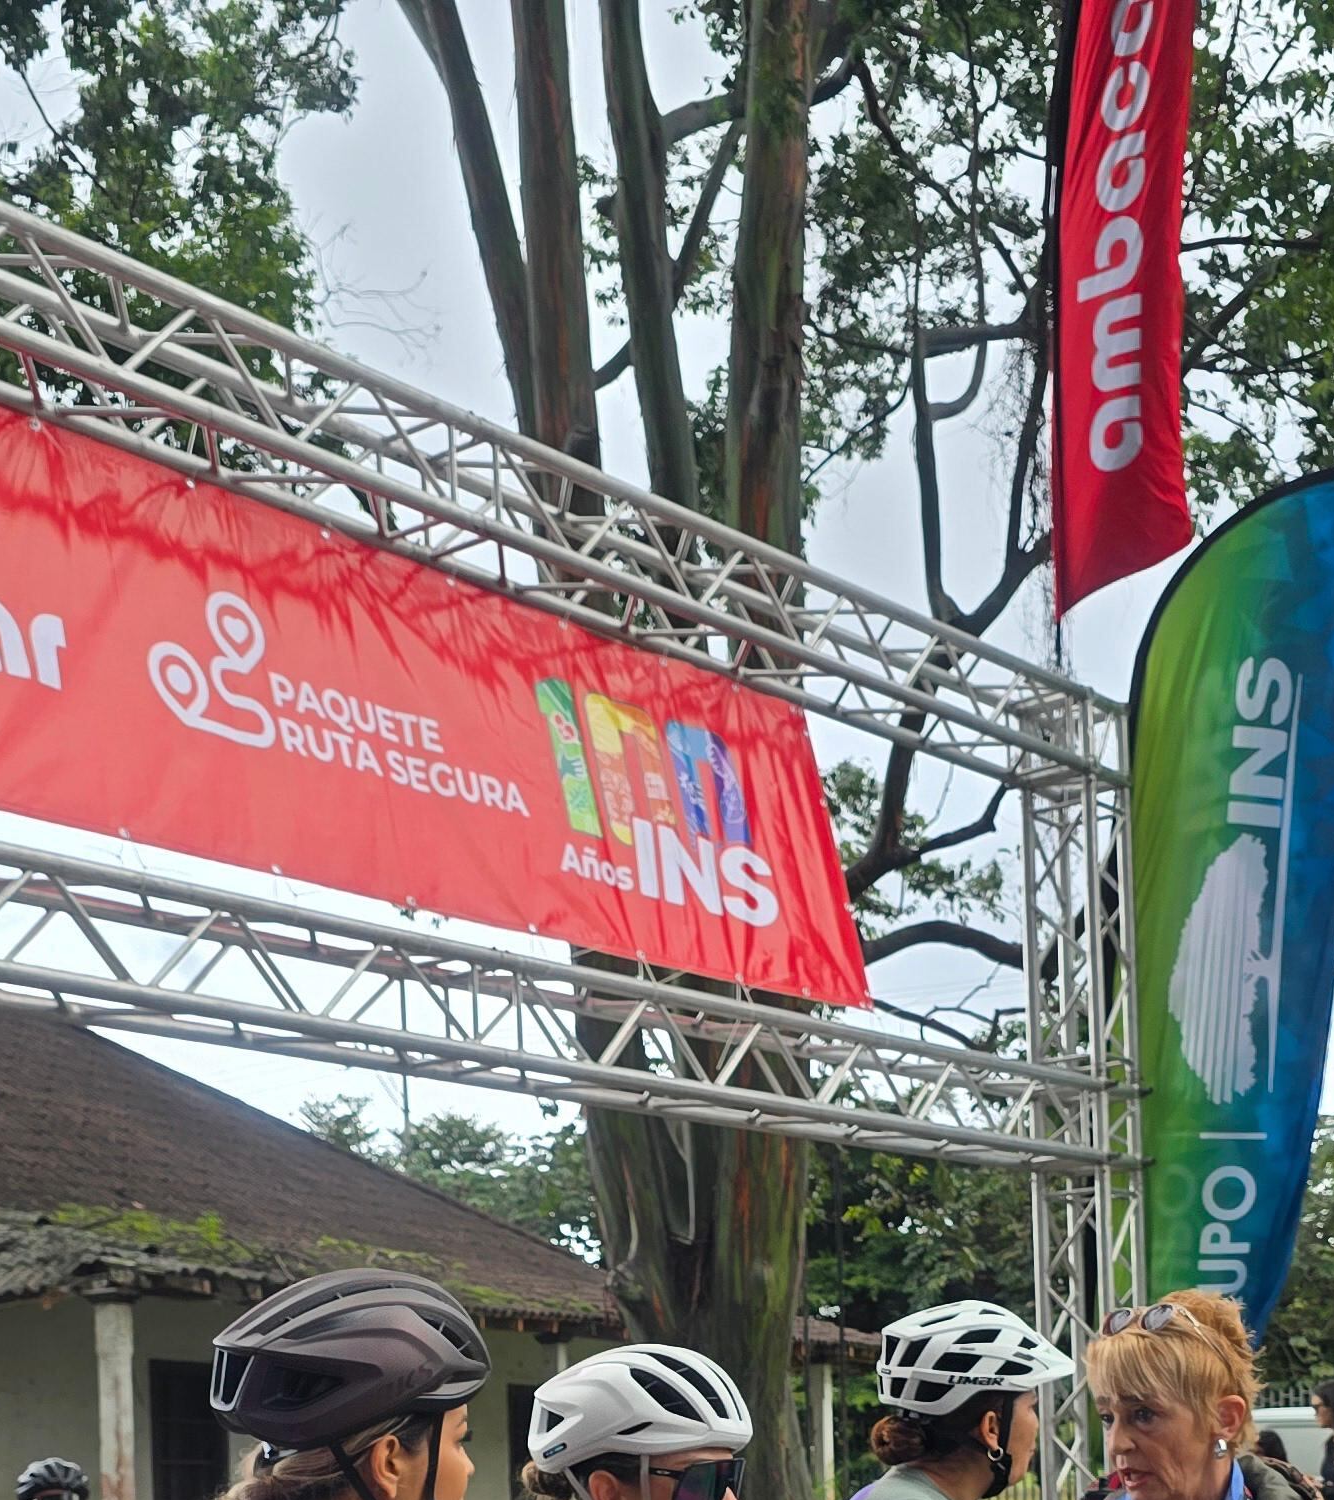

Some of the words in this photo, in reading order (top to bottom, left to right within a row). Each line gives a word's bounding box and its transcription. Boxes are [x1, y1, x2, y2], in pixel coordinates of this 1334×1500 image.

[1076, 0, 1153, 473] ambaca
[269, 671, 444, 755] PAQUETE
[278, 723, 384, 778] RUTA
[389, 755, 531, 818] SEGURA
[1227, 656, 1295, 829] INS
[560, 843, 634, 893] Años
[633, 818, 780, 928] INS
[1195, 1164, 1257, 1305] UPO
